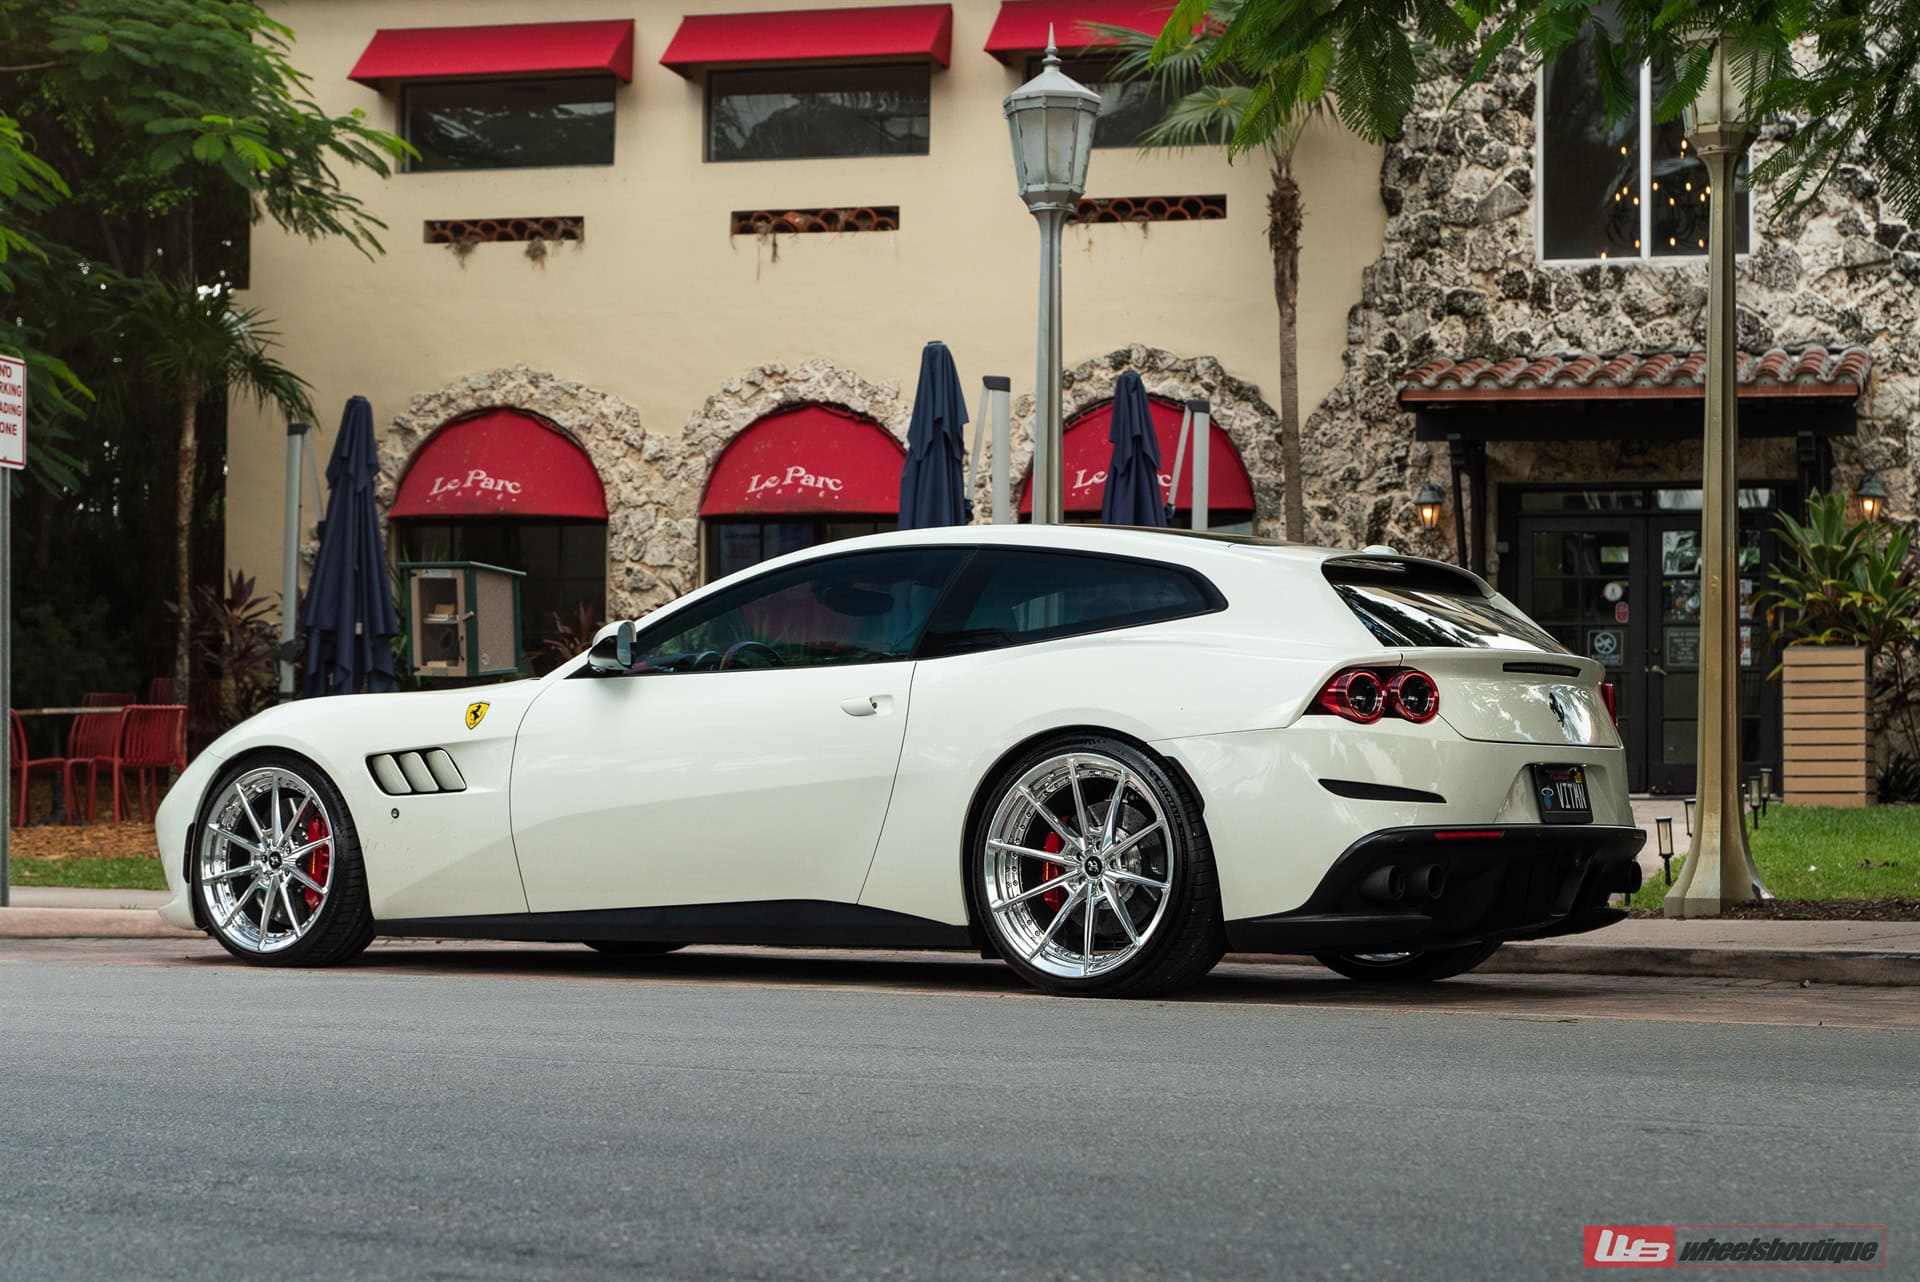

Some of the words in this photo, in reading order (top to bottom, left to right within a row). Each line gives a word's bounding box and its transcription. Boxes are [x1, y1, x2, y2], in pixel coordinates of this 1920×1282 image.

[0, 422, 17, 436] ONE
[429, 477, 460, 496] Le
[462, 469, 522, 494] Parc
[746, 474, 780, 494] Le
[782, 466, 843, 491] Parc
[1072, 469, 1108, 489] Le
